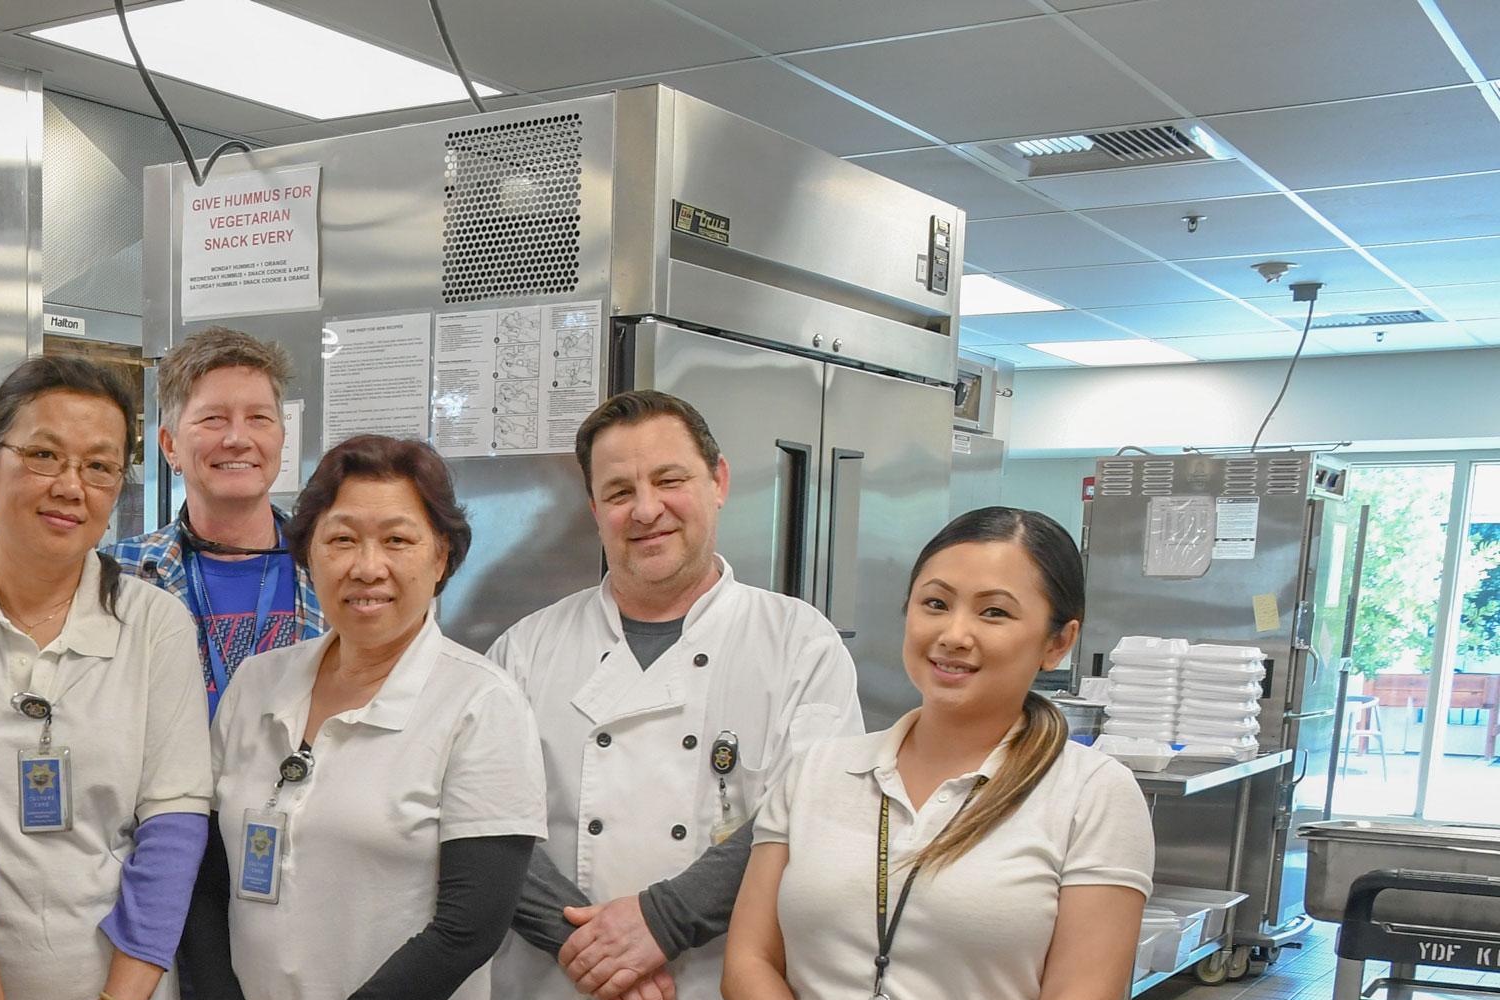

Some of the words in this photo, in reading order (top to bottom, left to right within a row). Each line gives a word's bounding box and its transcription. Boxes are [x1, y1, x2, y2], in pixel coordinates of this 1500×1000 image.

[192, 197, 221, 211] GIVE
[224, 189, 280, 207] HUMMUS
[284, 185, 312, 200] FOR
[209, 208, 290, 229] VEGETARIAN
[204, 235, 248, 251] SNACK
[252, 229, 294, 245] EVERY
[264, 259, 287, 267] ORANGE
[189, 274, 220, 282] WEDNESDAY
[243, 278, 261, 286] SNACK
[261, 276, 282, 284] COOKIE
[288, 273, 310, 281] ORANGE
[50, 316, 79, 329] Halton
[879, 815, 889, 852] PROBATION
[879, 860, 887, 905] PROBATION
[1419, 941, 1462, 962] YDF
